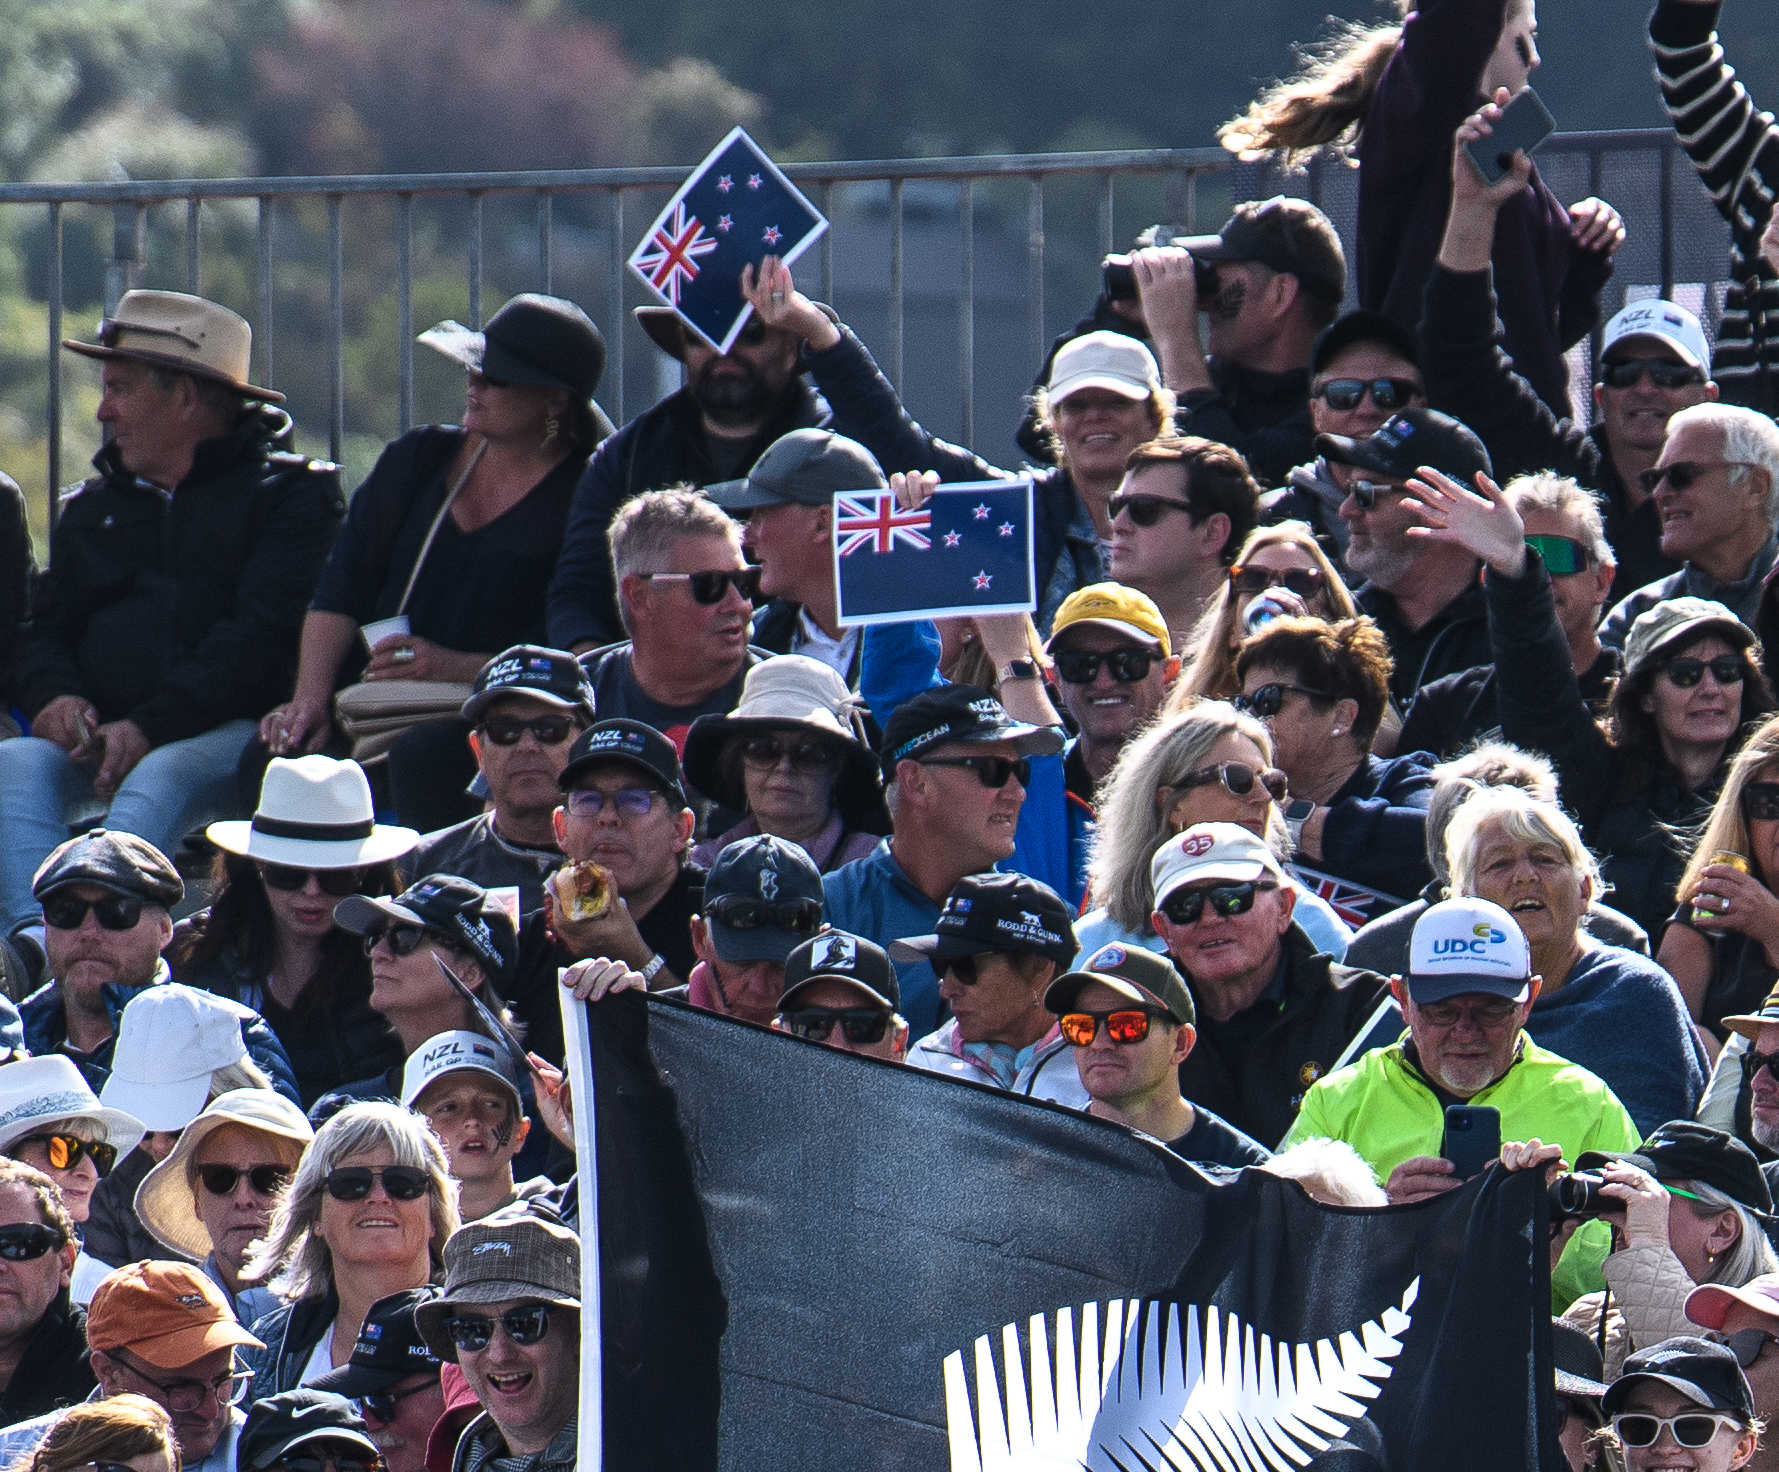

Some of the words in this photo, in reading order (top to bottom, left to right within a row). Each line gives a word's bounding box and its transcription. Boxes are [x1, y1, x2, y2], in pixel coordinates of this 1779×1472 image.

[489, 658, 523, 681] NZL
[590, 729, 623, 743] NZL
[1183, 837, 1212, 854] 35
[996, 918, 1028, 934] RODD
[1037, 928, 1064, 944] GUNN
[1433, 939, 1487, 955] UDC
[423, 1042, 466, 1068] NZL
